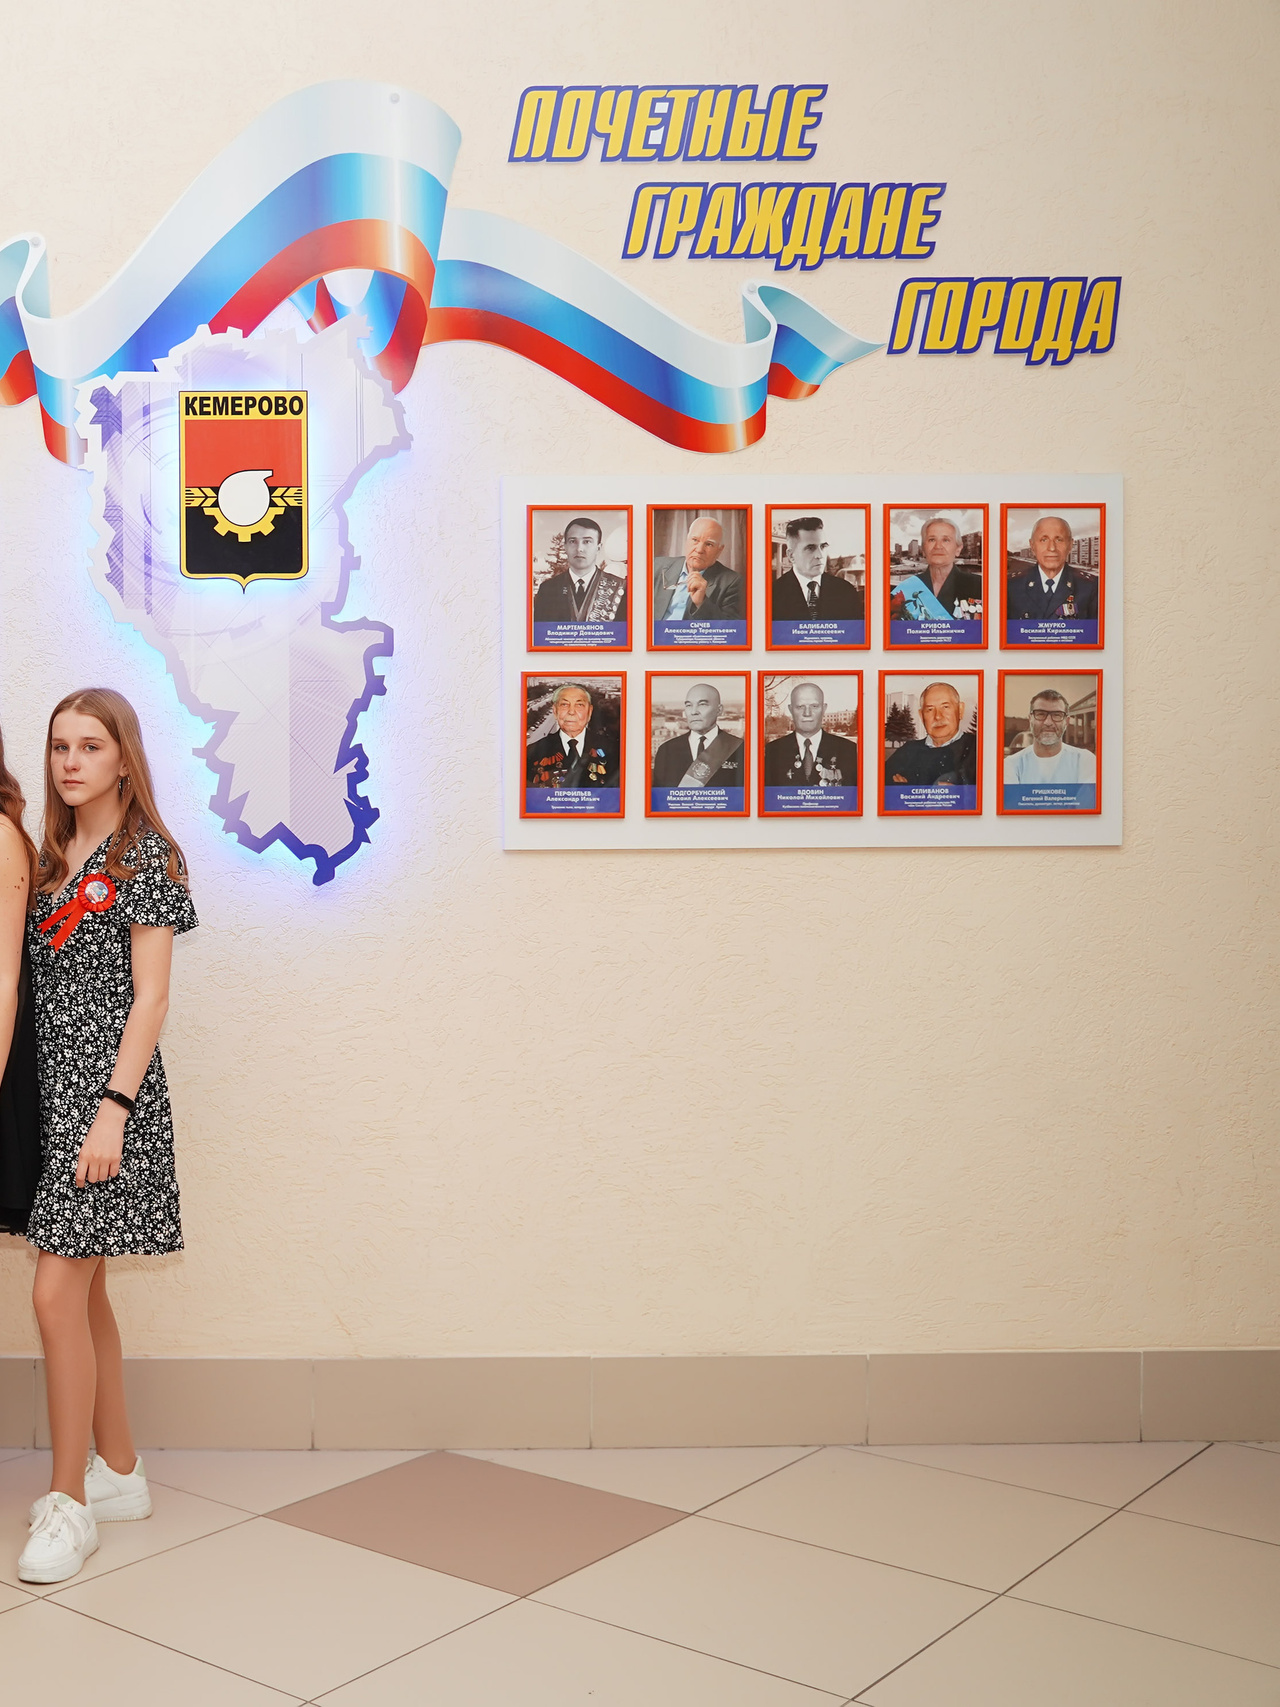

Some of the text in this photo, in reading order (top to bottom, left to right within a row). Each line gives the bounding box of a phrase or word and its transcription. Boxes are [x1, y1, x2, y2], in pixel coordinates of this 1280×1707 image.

[509, 84, 827, 161] ПОЧЕТНЫЕ
[622, 182, 946, 271] ГРАЖДАНЕ
[888, 276, 1121, 365] ГОРОДА
[185, 396, 304, 416] КЕМЕРОВО
